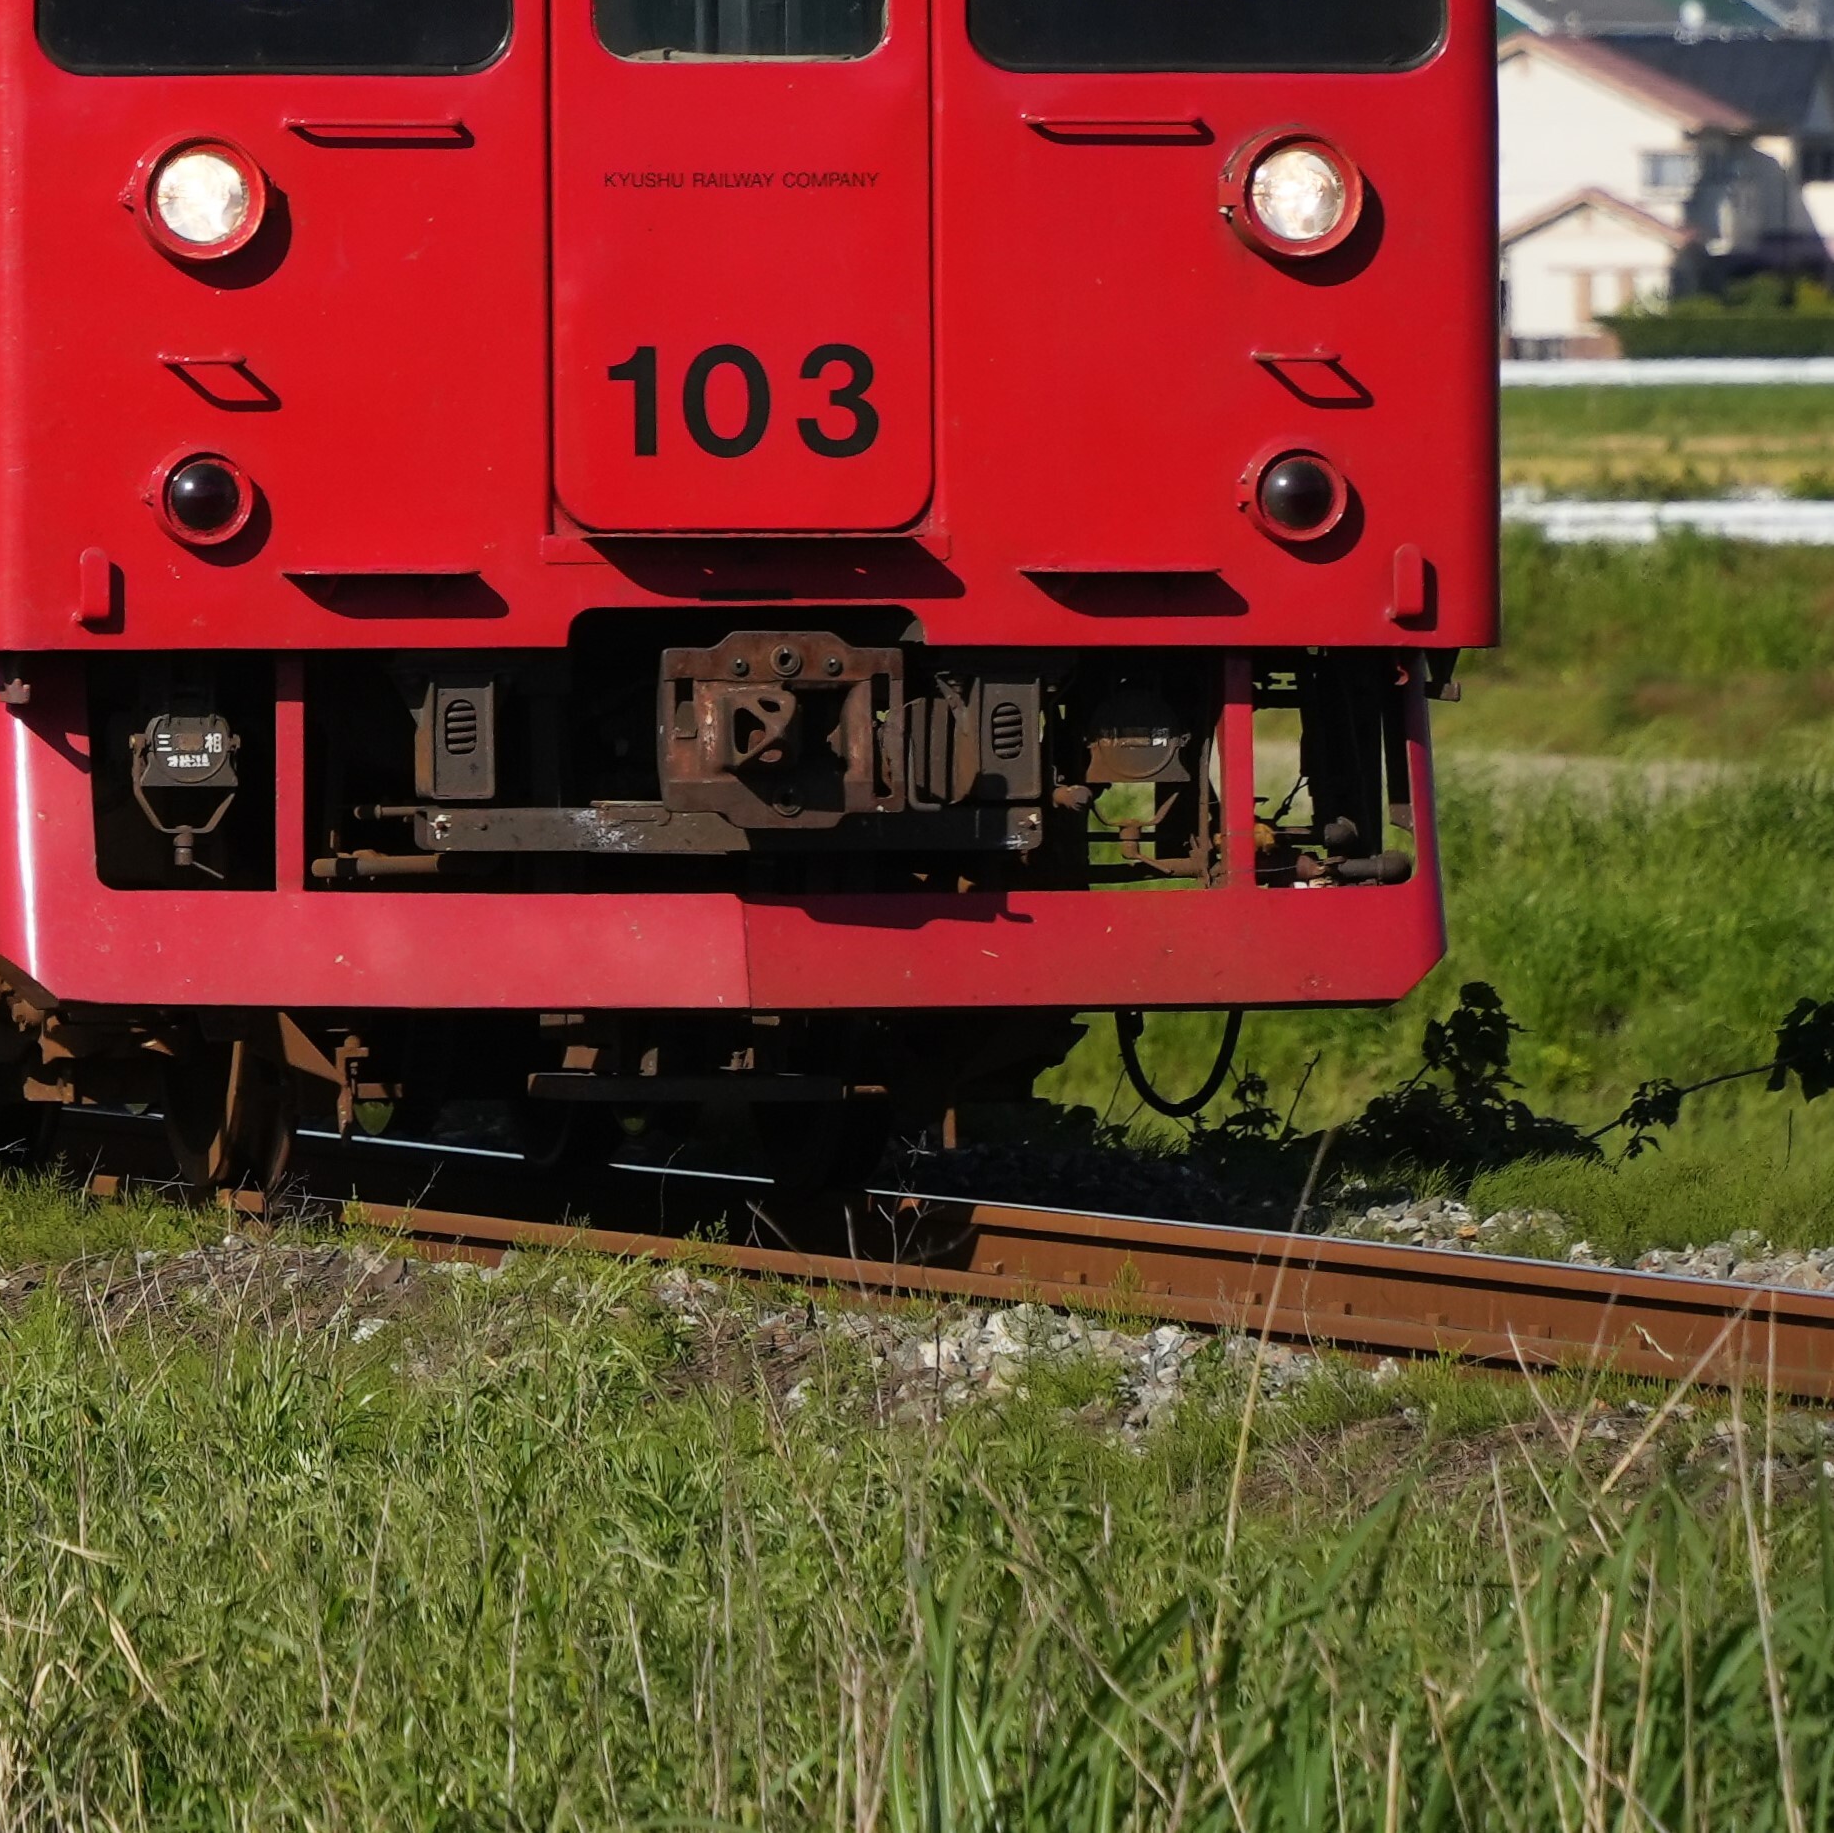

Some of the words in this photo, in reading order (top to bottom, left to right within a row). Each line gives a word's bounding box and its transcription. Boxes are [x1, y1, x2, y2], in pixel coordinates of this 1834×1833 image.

[604, 172, 684, 189] KYUSHU
[692, 172, 775, 189] RAILWAY
[782, 171, 880, 188] COMPANY
[607, 344, 879, 458] 103
